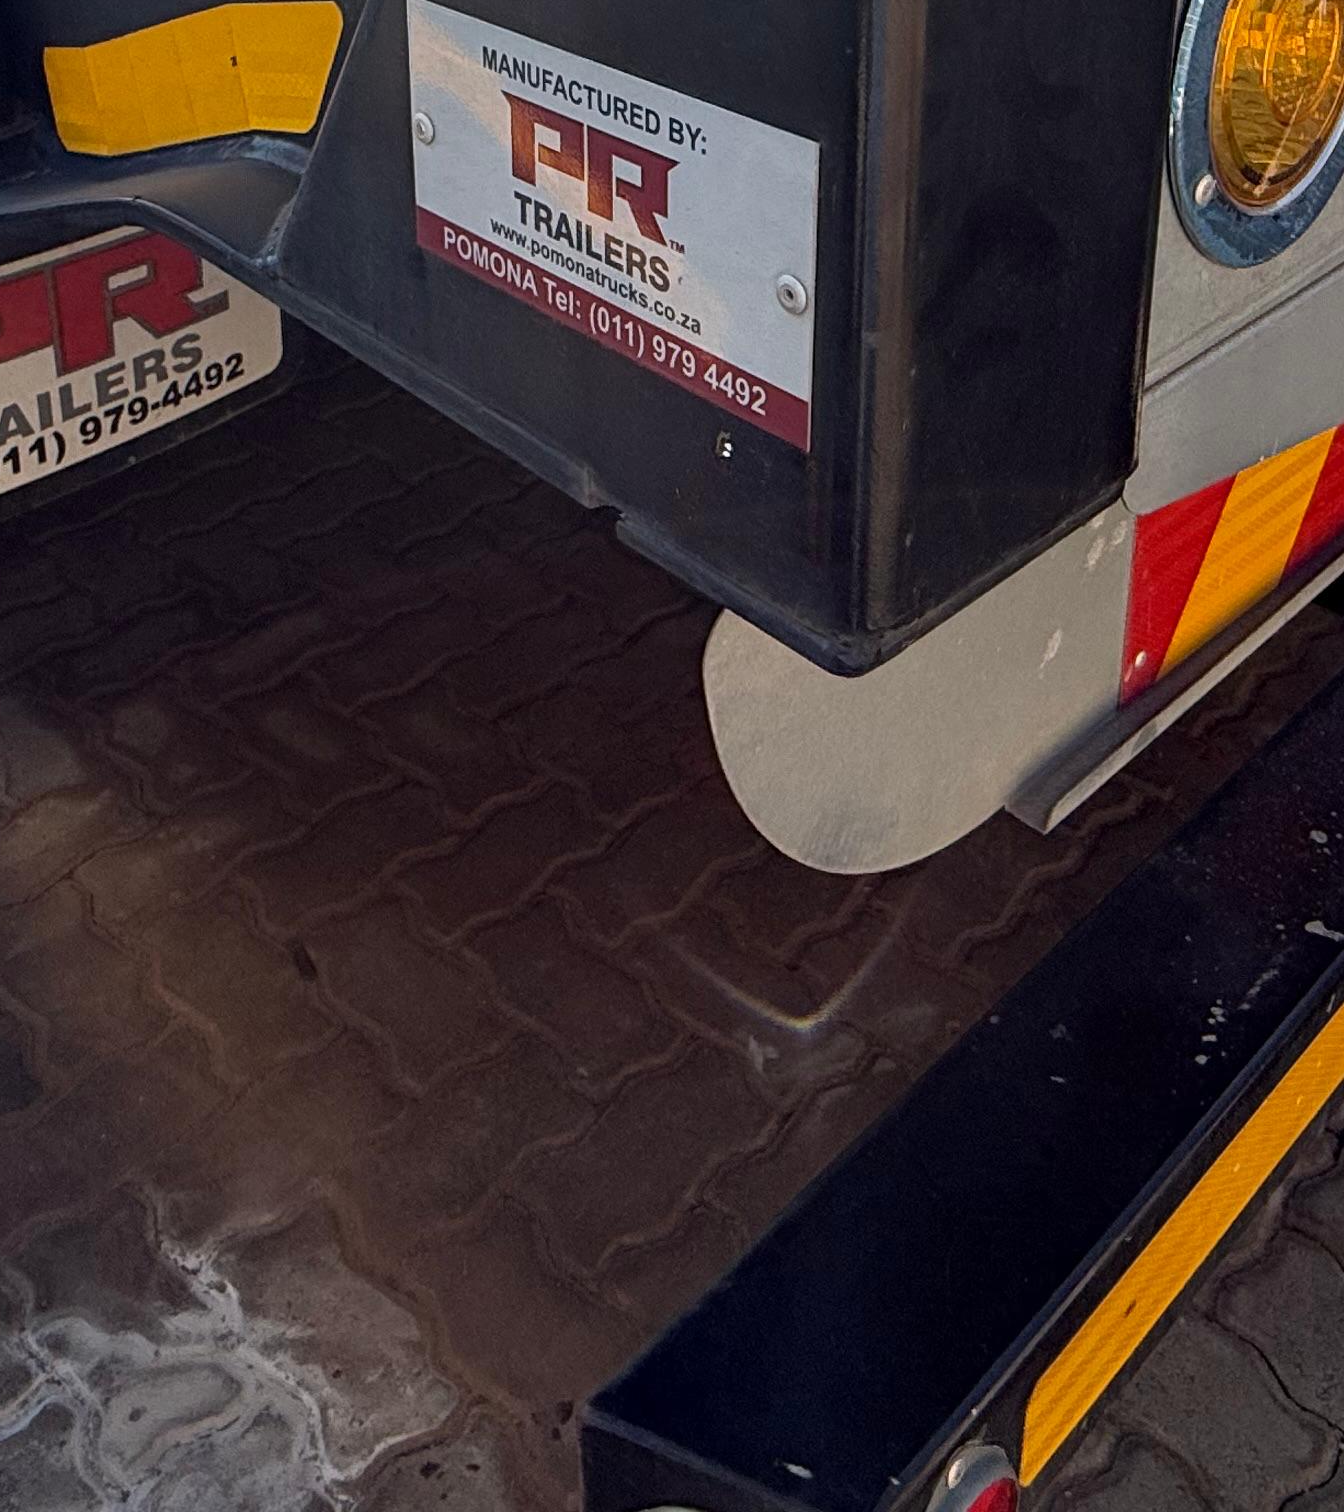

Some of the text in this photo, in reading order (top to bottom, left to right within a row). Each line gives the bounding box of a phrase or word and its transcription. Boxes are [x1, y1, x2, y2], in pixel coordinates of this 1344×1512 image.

[482, 46, 707, 156] MANUFACTURED BY:
[500, 89, 681, 248] PR
[490, 218, 702, 336] www.pomonatrucks.co.za
[513, 190, 671, 293] TRAILERS
[443, 226, 767, 417] POMONA Tel: (011) 979 4492
[80, 352, 245, 446] 979-4492
